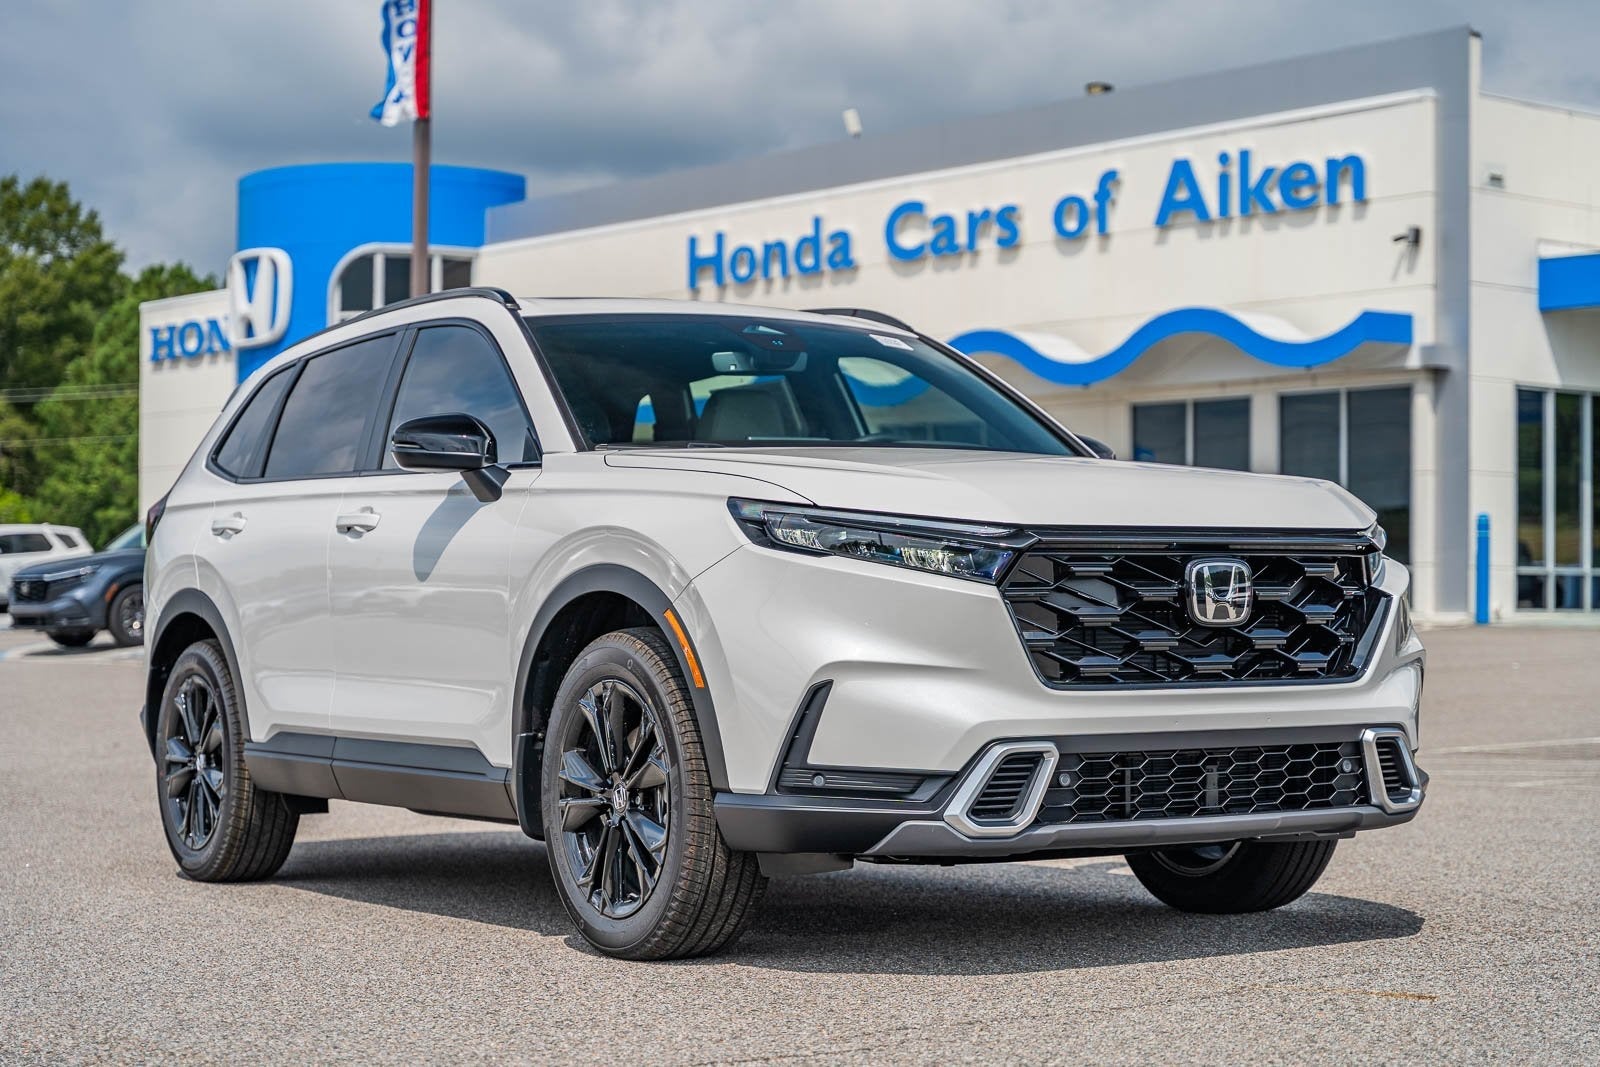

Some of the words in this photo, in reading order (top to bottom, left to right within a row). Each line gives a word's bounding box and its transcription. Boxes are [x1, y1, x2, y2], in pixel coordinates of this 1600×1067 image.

[687, 216, 855, 290] Honda
[884, 200, 1021, 262] Cars
[1052, 168, 1119, 240] of
[1154, 148, 1367, 228] Aiken
